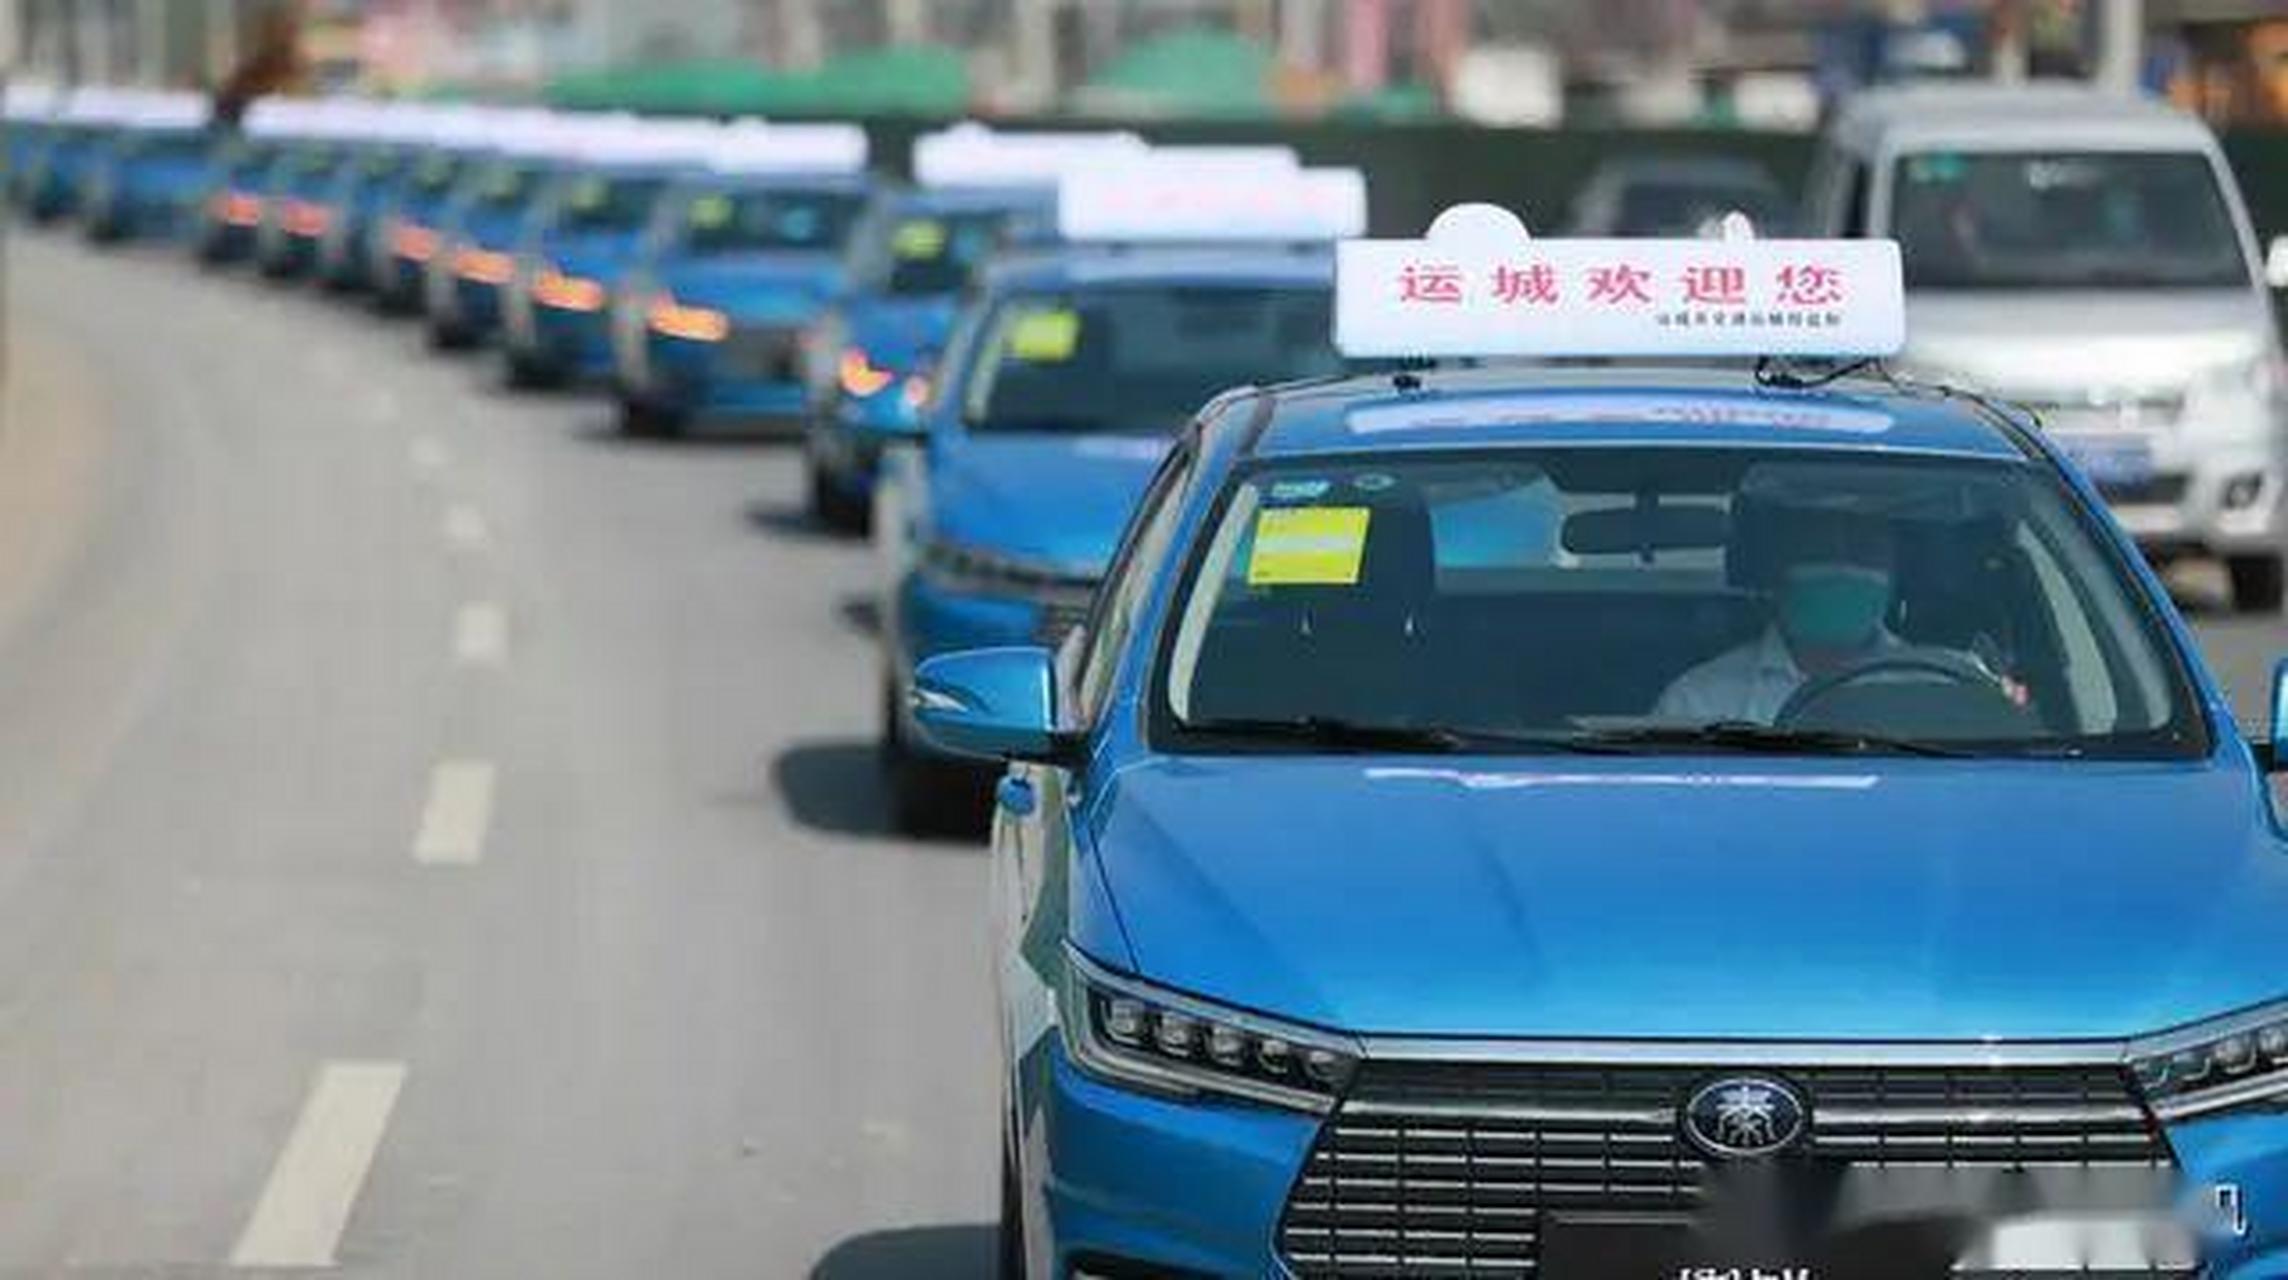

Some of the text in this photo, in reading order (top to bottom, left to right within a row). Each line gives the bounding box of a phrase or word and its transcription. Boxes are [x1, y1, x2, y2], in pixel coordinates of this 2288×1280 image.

[1399, 264, 1843, 304] 运城欢迎您
